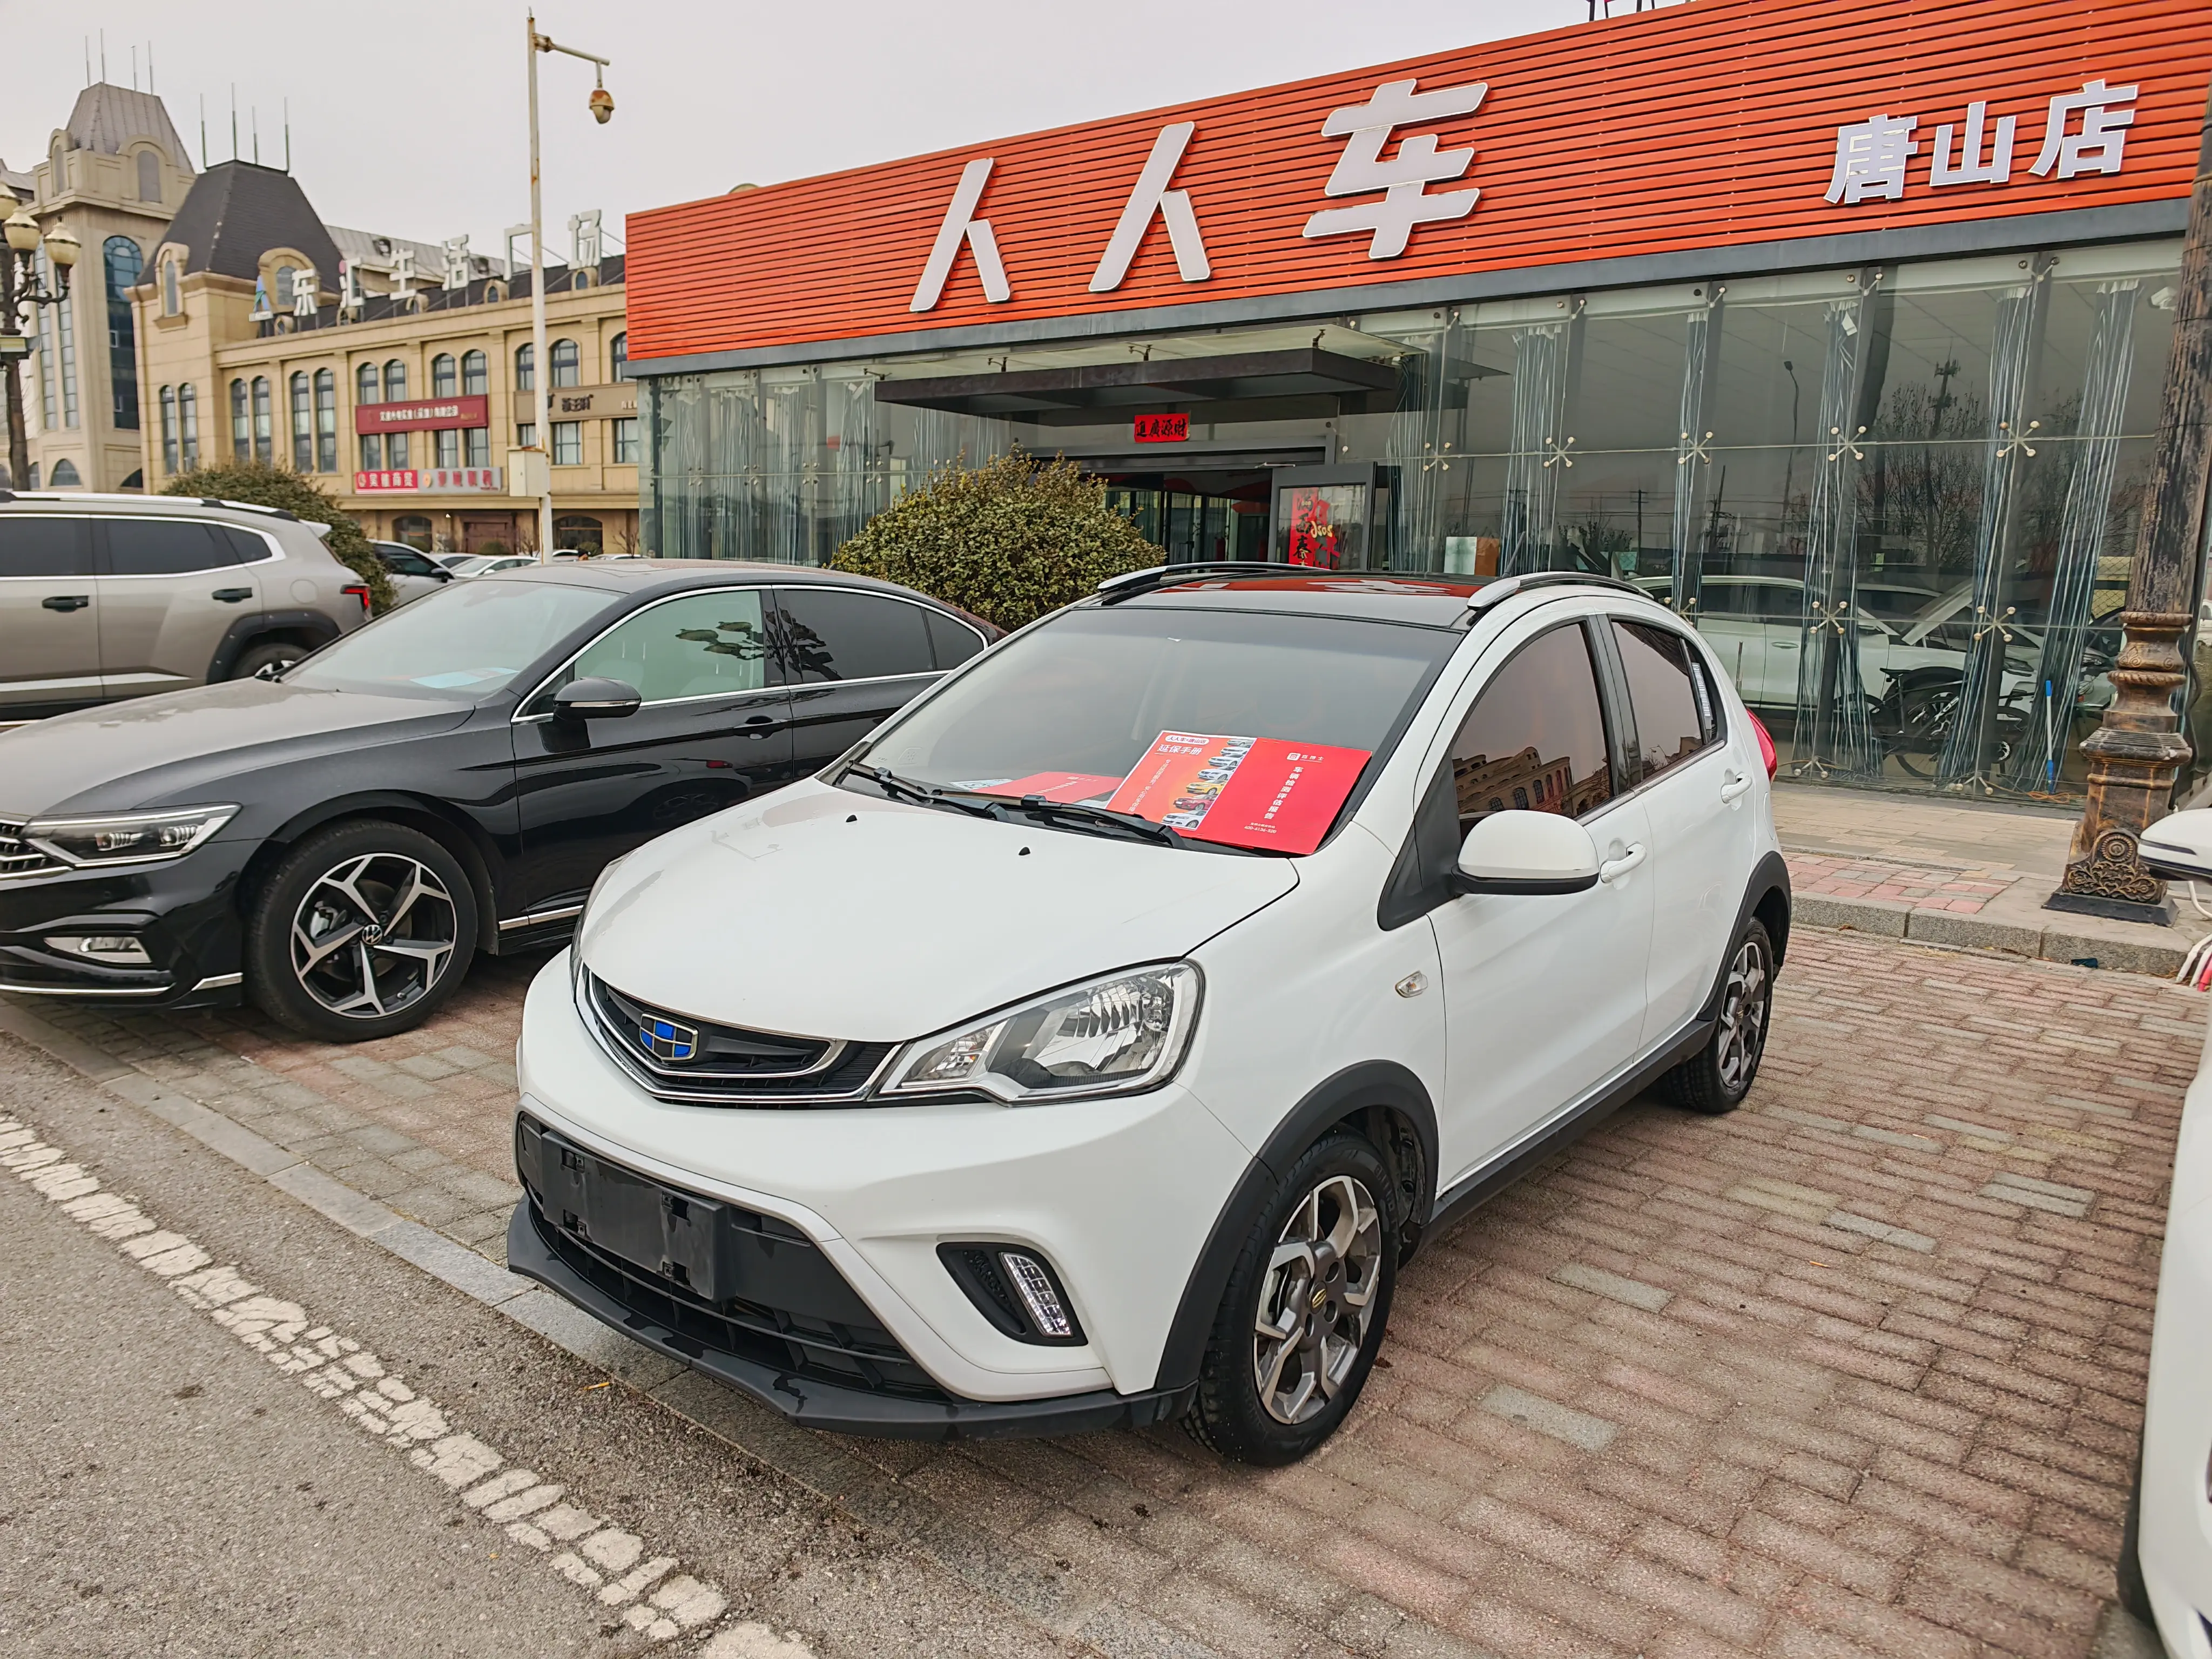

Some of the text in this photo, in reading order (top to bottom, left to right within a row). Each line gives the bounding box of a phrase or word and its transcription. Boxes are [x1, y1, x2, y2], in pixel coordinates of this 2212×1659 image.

[909, 78, 1488, 312] 人人车
[1823, 79, 2139, 204] 唐山店
[292, 209, 601, 316] 东汇生活广场
[1157, 744, 1203, 756] 延保手册
[1264, 766, 1304, 819] 车辆检测评估报告
